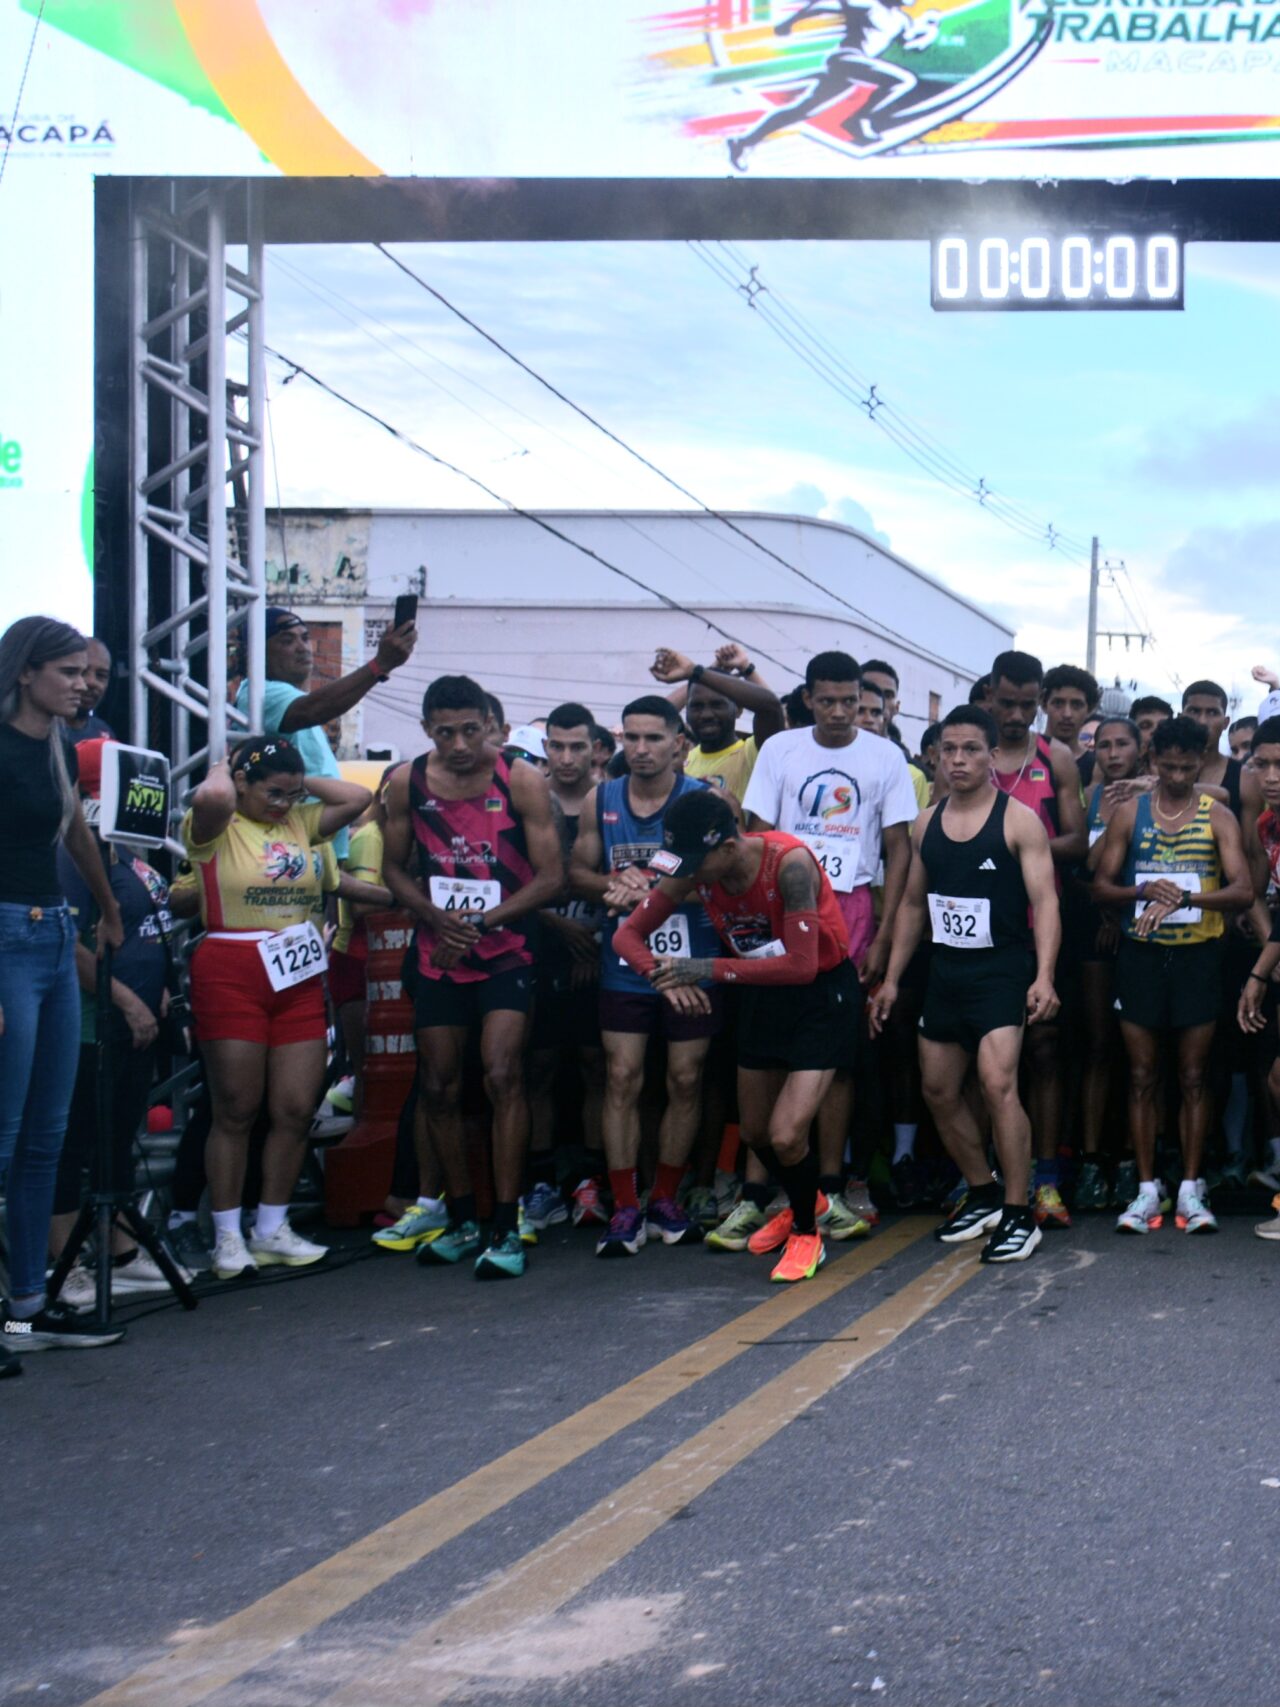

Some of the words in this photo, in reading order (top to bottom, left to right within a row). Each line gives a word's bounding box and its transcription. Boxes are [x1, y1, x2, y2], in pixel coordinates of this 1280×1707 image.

[938, 236, 1179, 300] 00:00:00
[943, 911, 977, 938] 932
[650, 930, 683, 954] 69
[272, 938, 322, 977] 1229
[4, 1320, 33, 1334] CORRE
